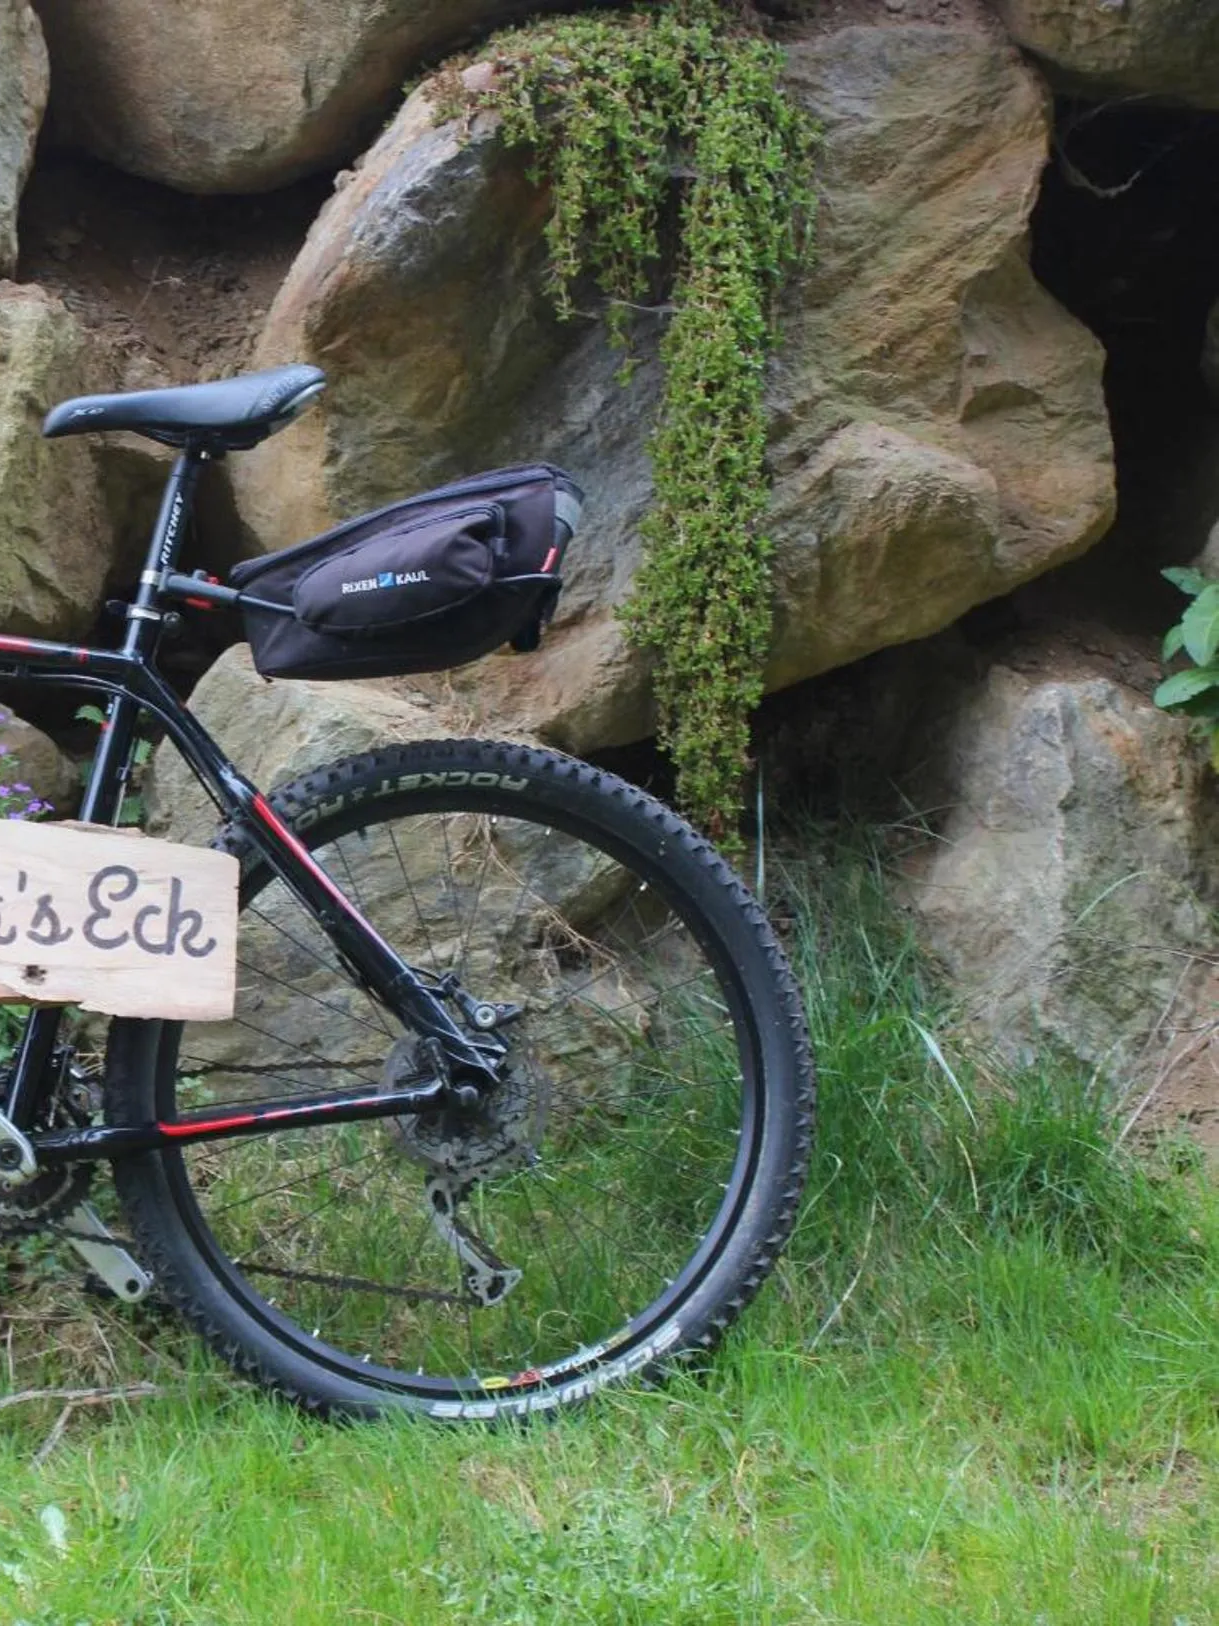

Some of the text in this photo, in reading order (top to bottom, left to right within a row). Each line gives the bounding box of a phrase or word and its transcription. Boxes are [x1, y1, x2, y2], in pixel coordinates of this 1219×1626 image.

[159, 491, 185, 565] RITCHEY
[341, 569, 430, 595] RIXEN KAUL
[293, 769, 530, 832] ROCKET RO
[82, 864, 217, 959] Eck
